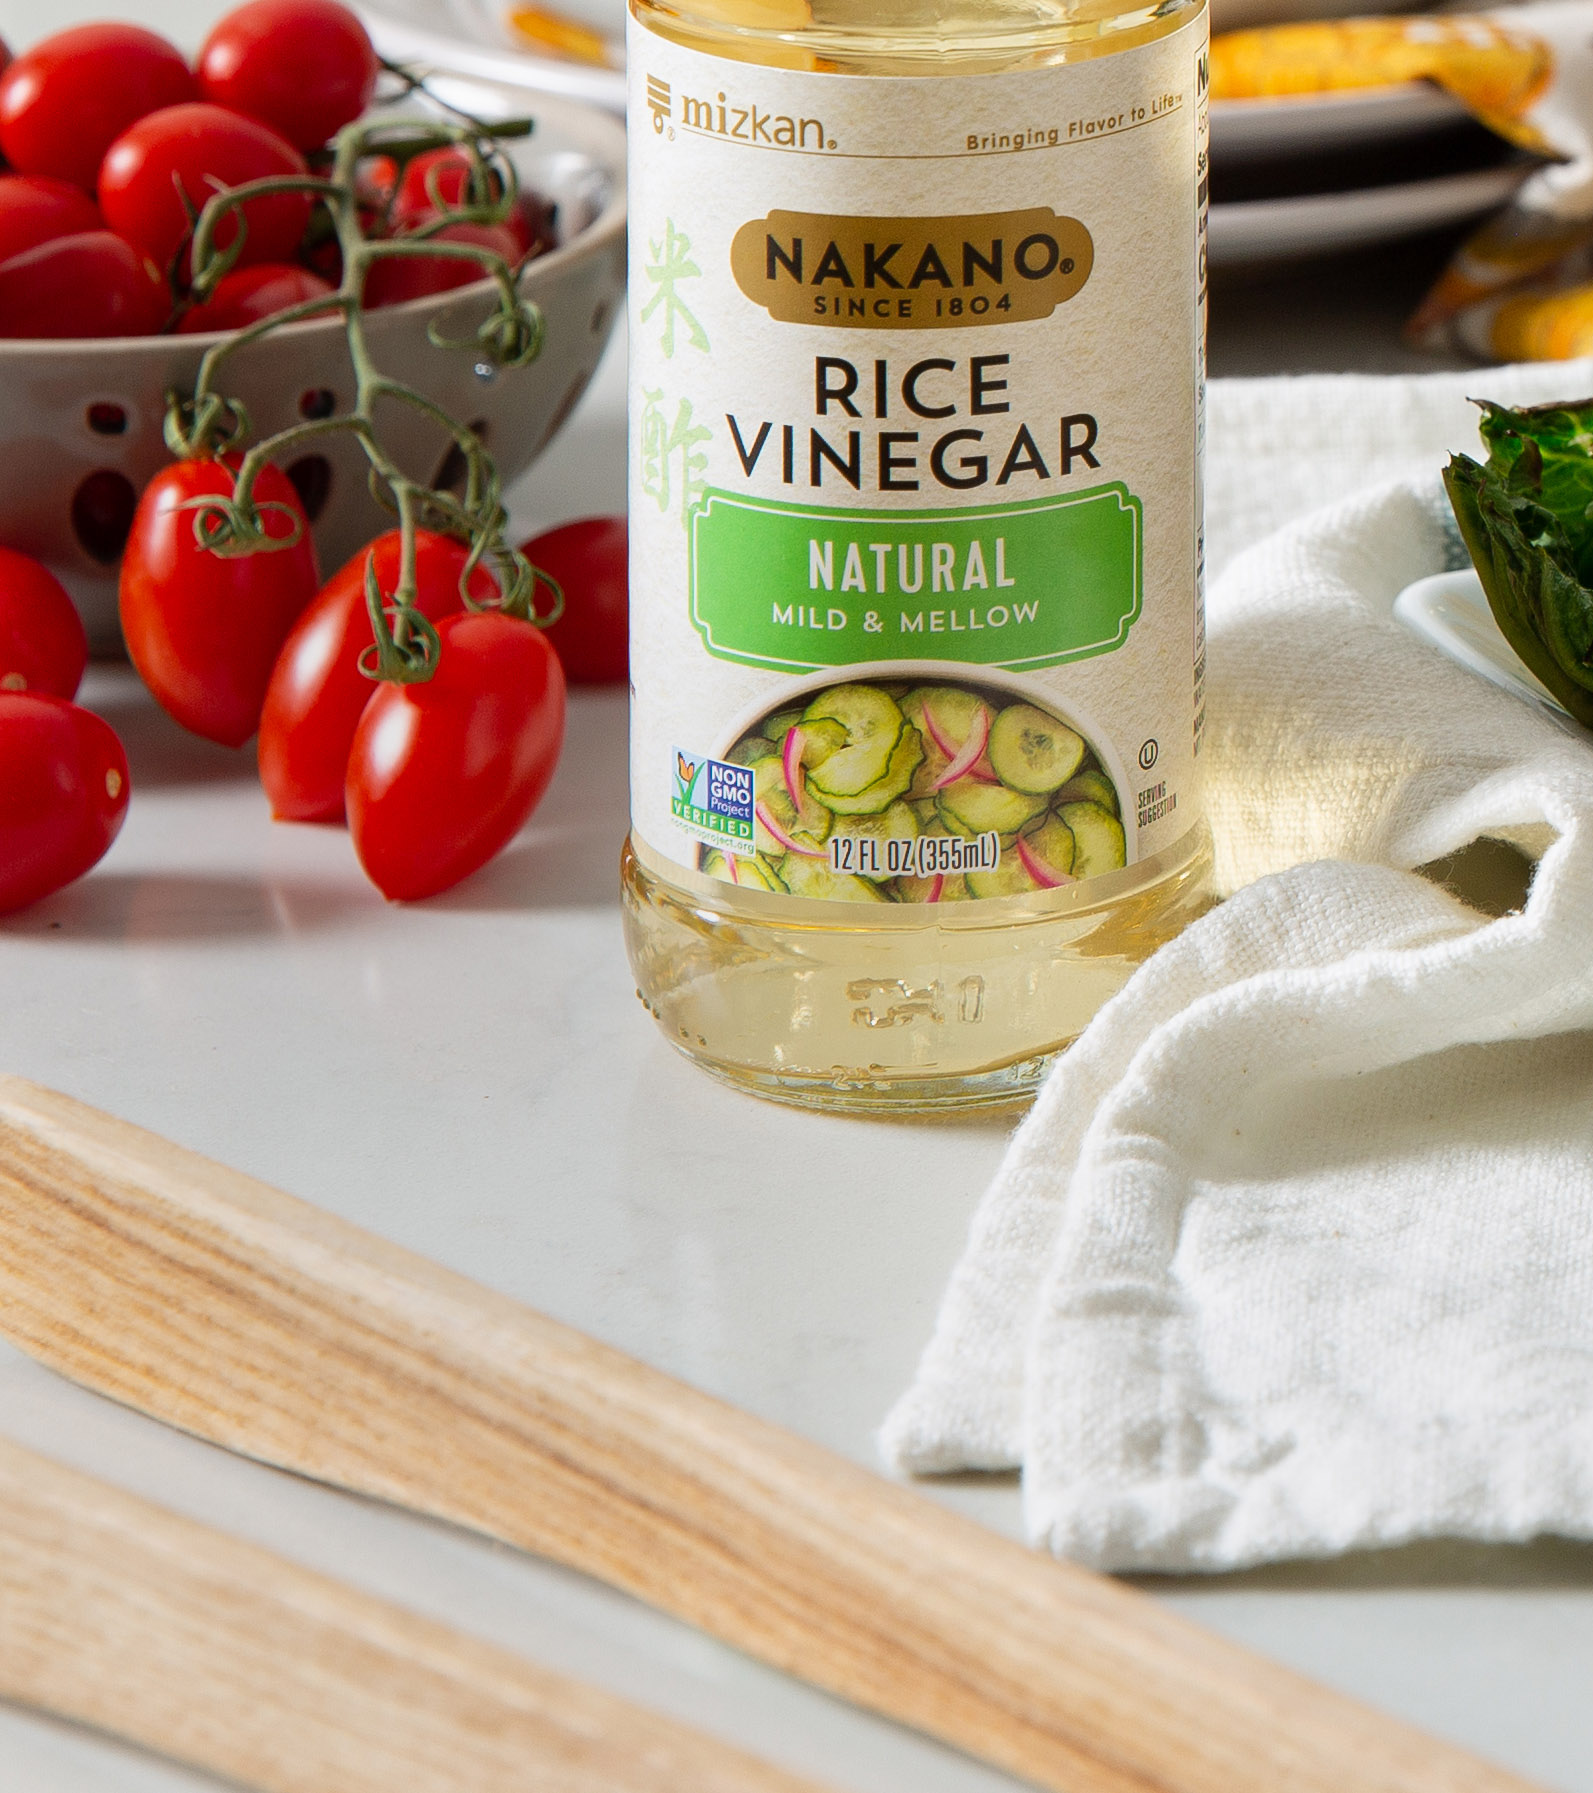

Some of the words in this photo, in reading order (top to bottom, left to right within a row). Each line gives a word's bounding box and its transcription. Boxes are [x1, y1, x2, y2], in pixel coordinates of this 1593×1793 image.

[681, 91, 825, 150] mizkan
[967, 127, 1059, 151] Bringing
[1068, 113, 1125, 138] Flavor
[1130, 106, 1146, 122] to
[766, 233, 1060, 290] NAKANO
[813, 295, 912, 318] SINCE
[935, 293, 1011, 318] 1804
[816, 353, 1010, 419] RICE
[725, 413, 1102, 491] VINEGAR
[809, 537, 1016, 594] NATURAL
[772, 601, 848, 631] MILD
[863, 610, 884, 633] &
[900, 599, 1040, 633] MELLOW
[710, 781, 751, 805] GMO
[711, 765, 750, 789] NON
[1138, 780, 1167, 810] SERVING
[673, 799, 751, 838] VERIFIED
[710, 796, 751, 818] Project
[1138, 793, 1177, 829] SUGGESTION
[831, 838, 853, 870] 12
[858, 840, 880, 872] FL
[887, 840, 913, 872] OZ
[918, 833, 998, 874] (355mL)
